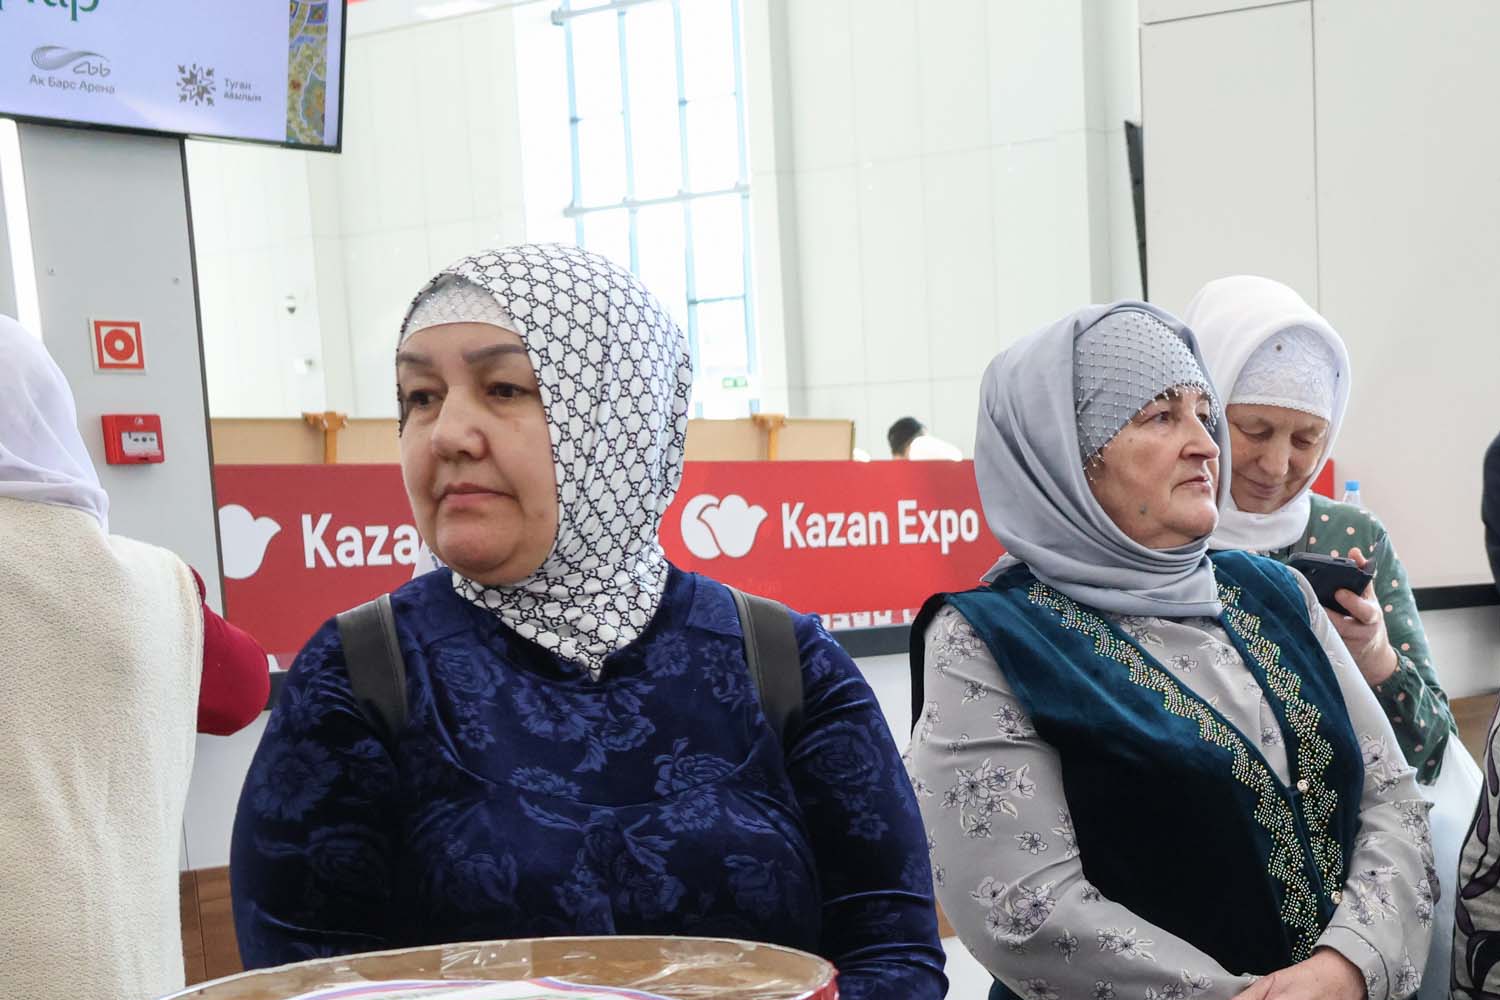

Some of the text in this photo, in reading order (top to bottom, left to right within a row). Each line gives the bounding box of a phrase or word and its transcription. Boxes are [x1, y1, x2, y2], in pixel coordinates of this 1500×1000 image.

[29, 74, 116, 95] Ак Барс Арена
[301, 513, 417, 568] Kaza
[782, 499, 980, 554] Kazan Expo
